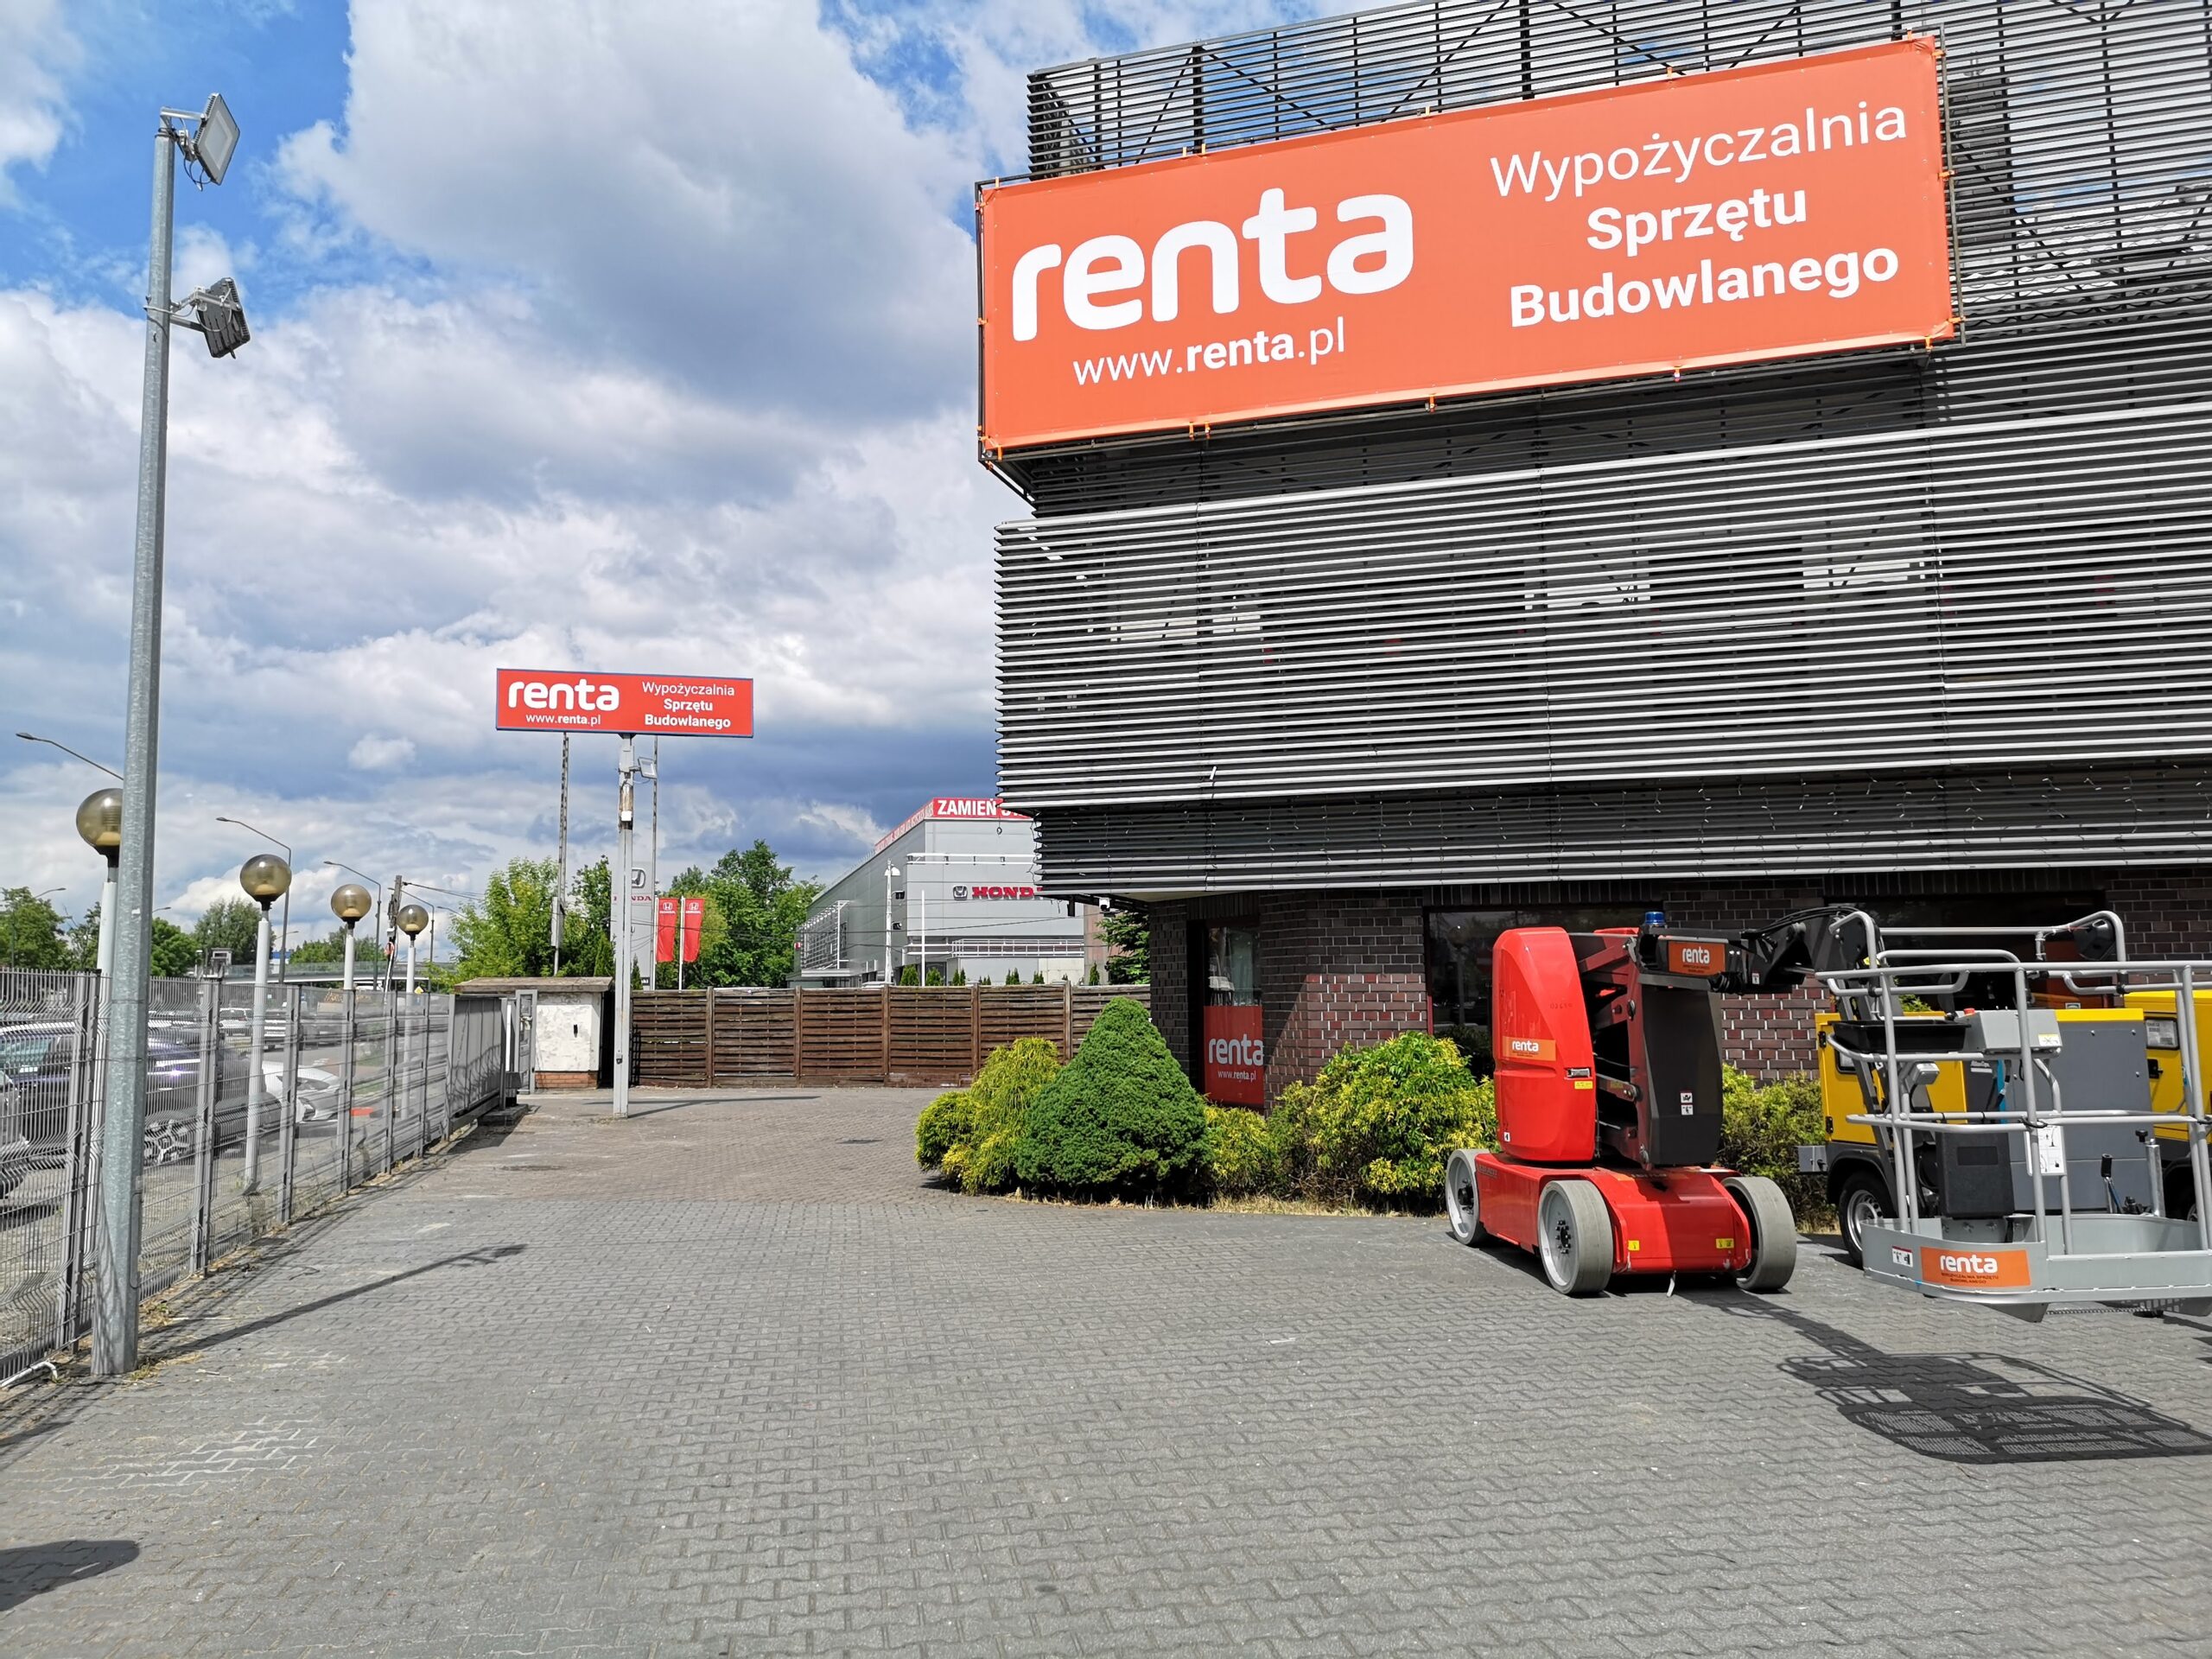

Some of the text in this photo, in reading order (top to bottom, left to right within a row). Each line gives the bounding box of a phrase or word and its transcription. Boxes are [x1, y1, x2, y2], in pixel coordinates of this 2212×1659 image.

[1491, 99, 1908, 204] Wypożyczalnia
[1587, 188, 1807, 257] Sprzętu
[1012, 188, 1414, 341] renta
[1510, 248, 1899, 327] Budowlanego
[1073, 316, 1345, 385] www.renta.pl
[508, 678, 620, 711] renta
[642, 681, 735, 696] Wypożyczalnia
[664, 698, 713, 713] Sprzętu
[525, 714, 601, 727] www.renta.pl
[645, 714, 731, 730] Budowlanego
[971, 887, 1043, 899] HOND
[1681, 945, 1710, 964] renta
[1208, 1033, 1264, 1066] renta
[1512, 1039, 1539, 1052] renta
[1217, 1070, 1256, 1083] www.renta.pl
[1940, 1255, 1998, 1274] renta
